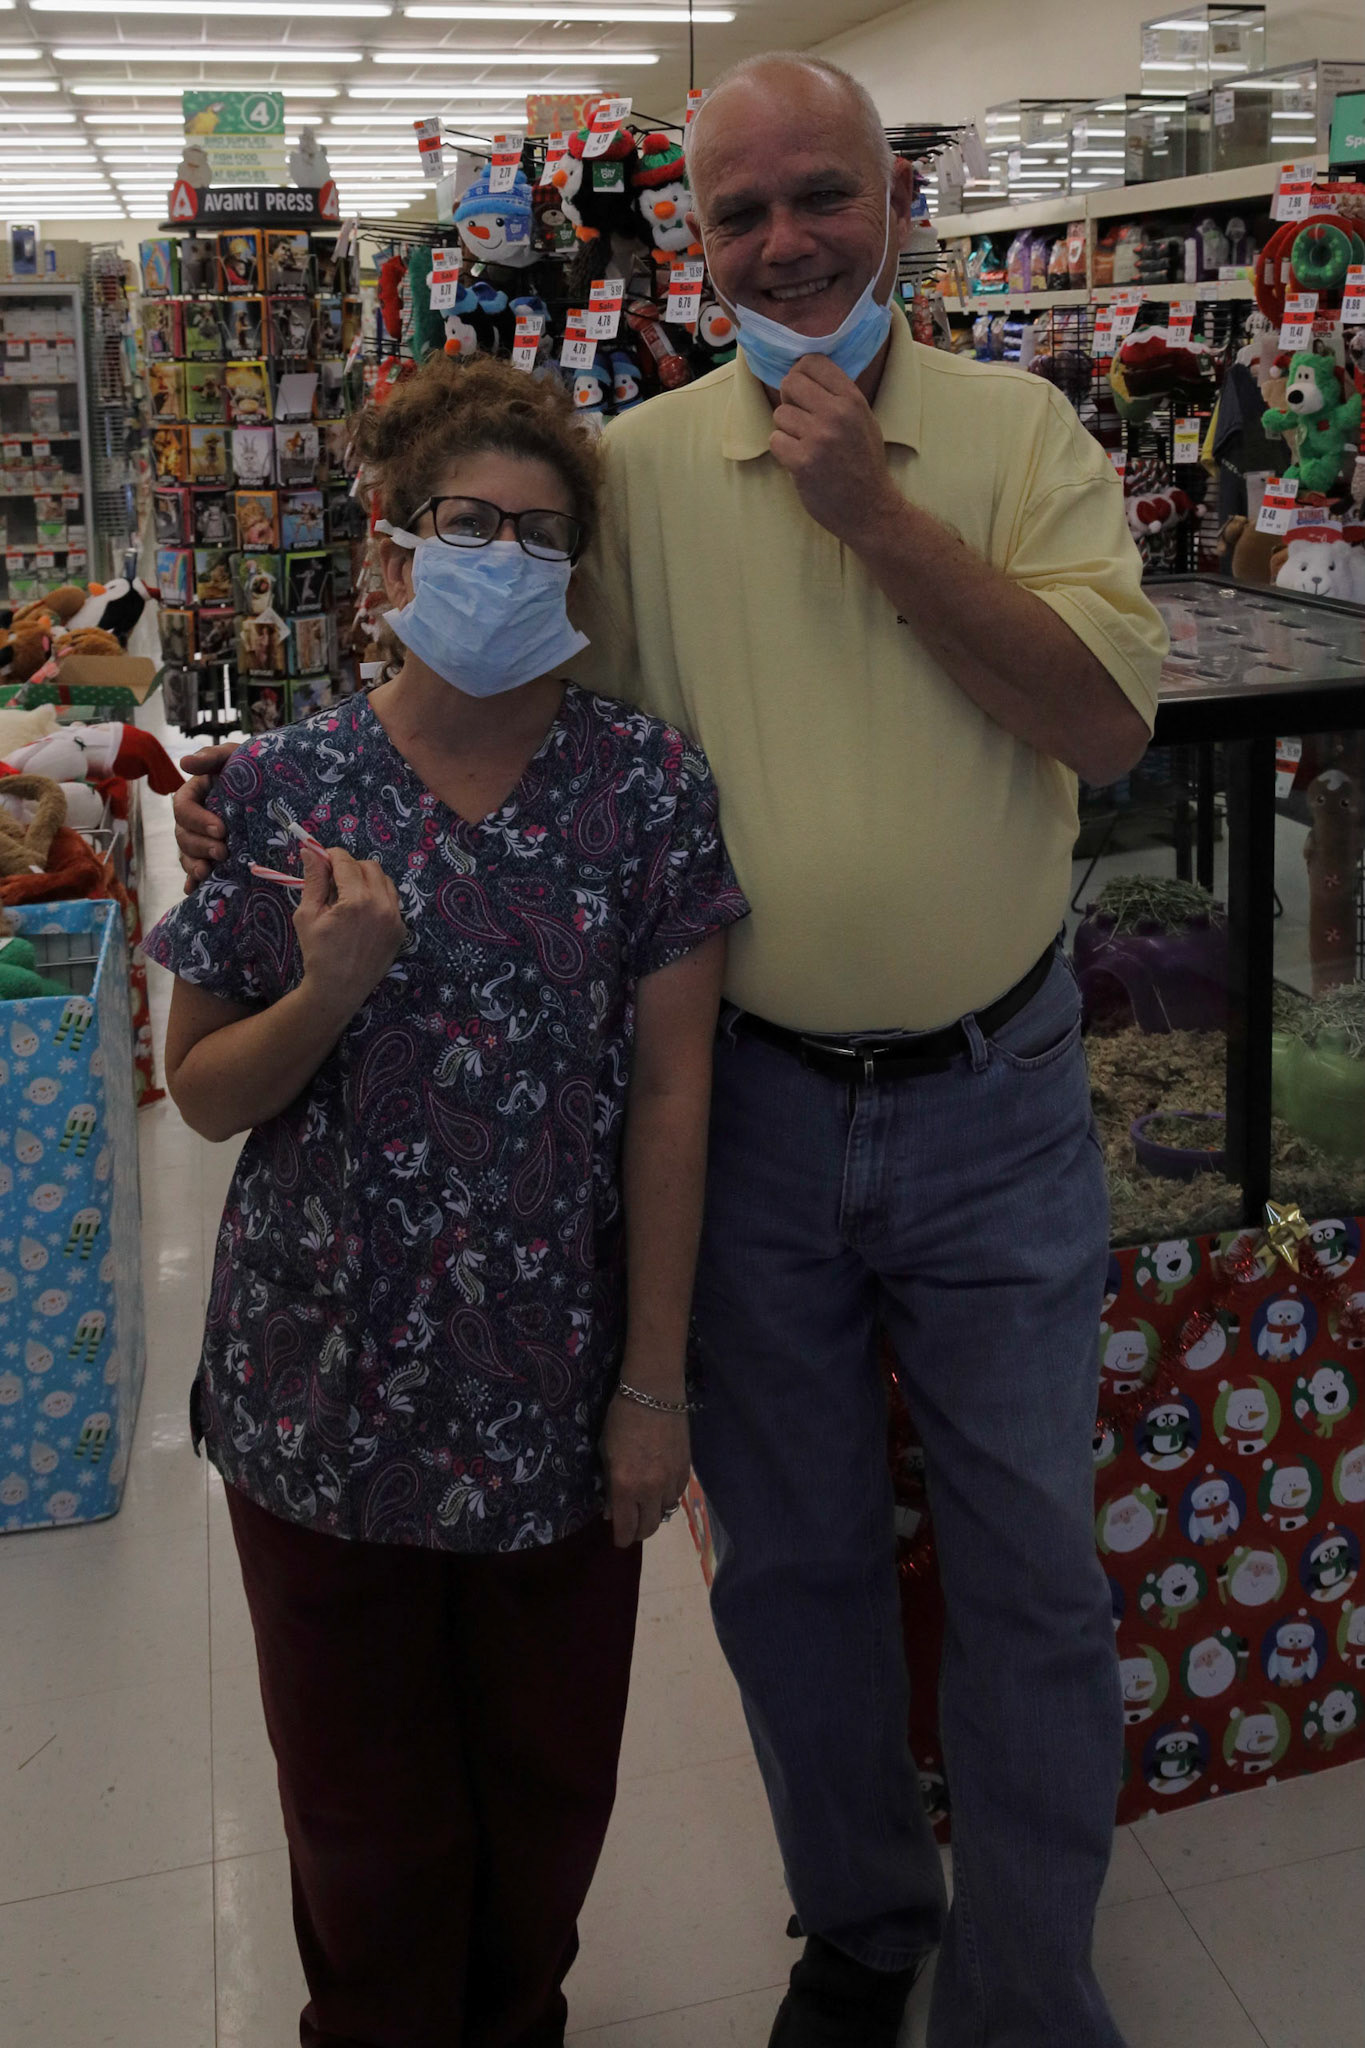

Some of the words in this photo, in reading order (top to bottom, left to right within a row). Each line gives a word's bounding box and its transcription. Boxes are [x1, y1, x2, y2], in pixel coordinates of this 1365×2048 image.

[249, 101, 270, 126] 4
[680, 283, 694, 291] Sale
[598, 302, 614, 310] Sale
[678, 297, 692, 308] 6.78
[598, 315, 611, 326] 4.78
[573, 344, 587, 354] 4.78
